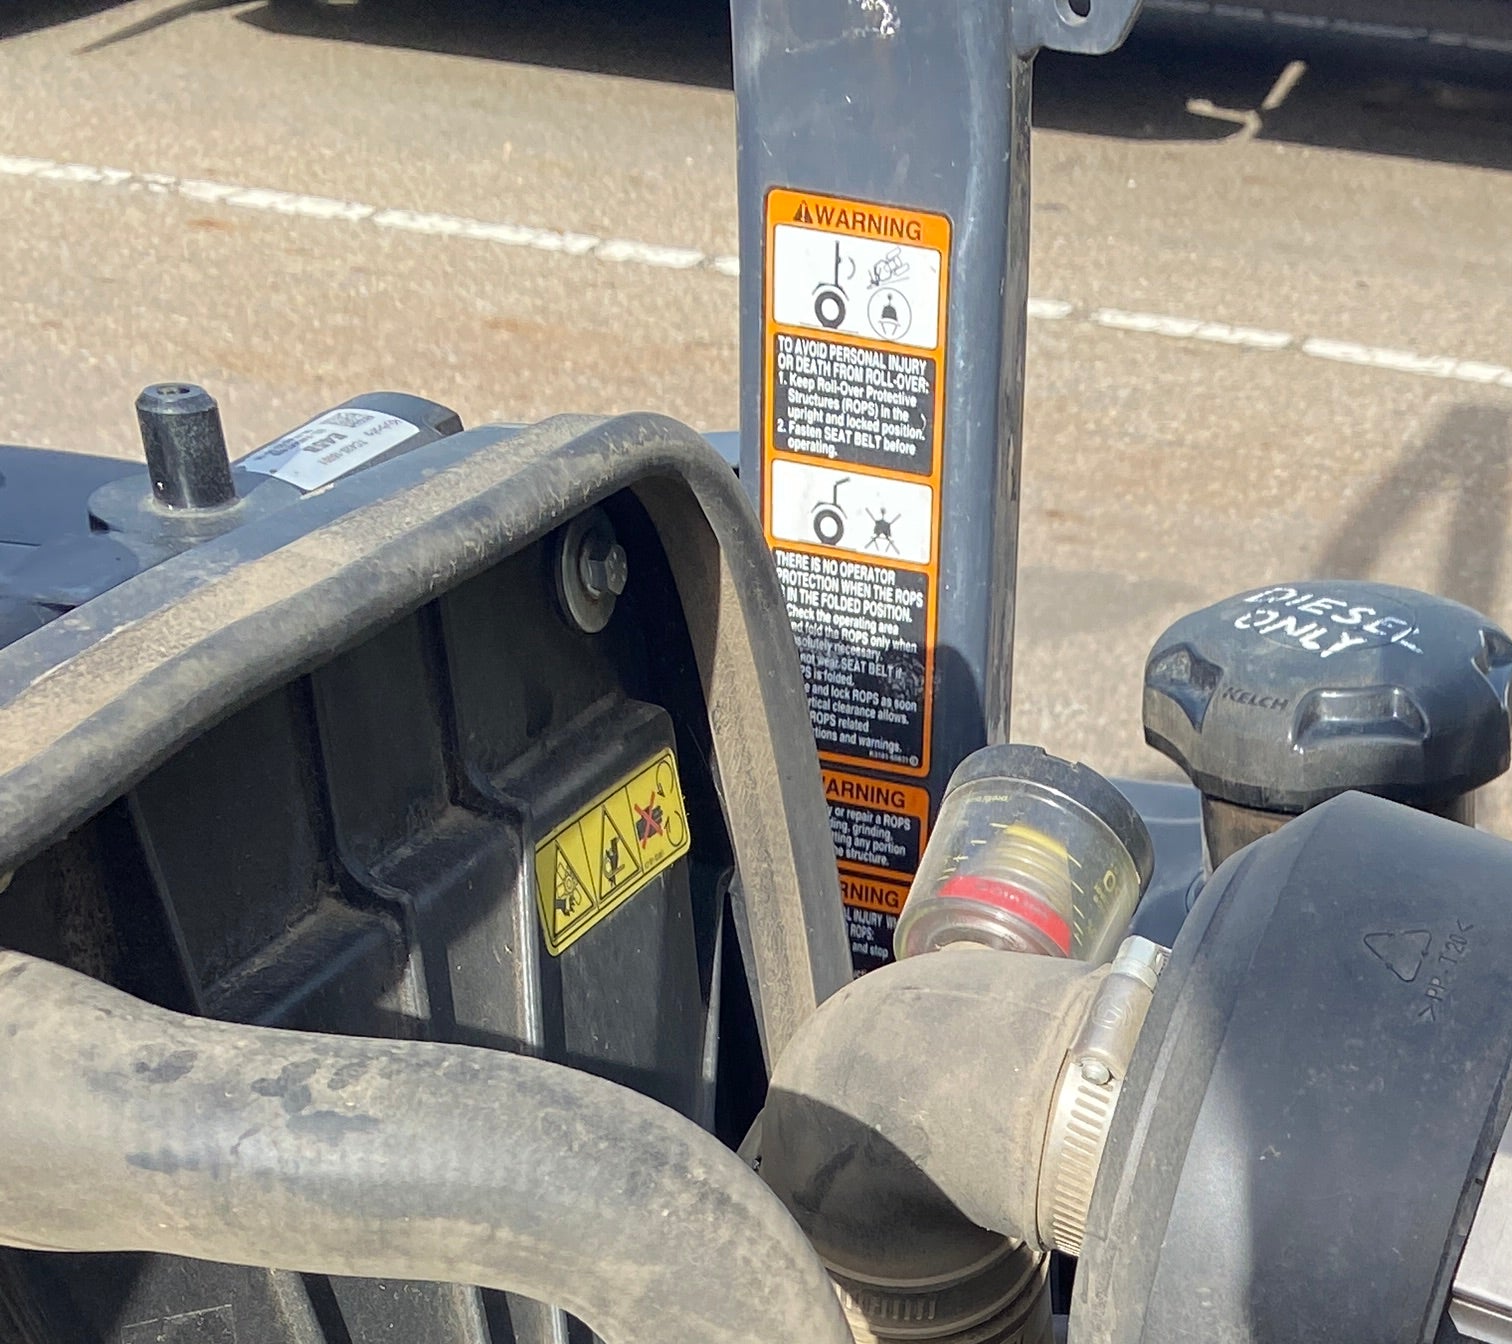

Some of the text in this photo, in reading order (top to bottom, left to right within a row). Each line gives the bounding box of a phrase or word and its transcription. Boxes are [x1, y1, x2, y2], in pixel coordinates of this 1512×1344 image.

[815, 203, 922, 241] WARNING
[777, 334, 927, 376] TO AVOID PERSONAL INJURY
[777, 352, 930, 395] OR DEATH FROM ROLL-OVER:
[778, 371, 918, 408] 1. Keep Roll-Over Protective
[787, 387, 910, 423] Structures (ROPS) in the
[787, 405, 926, 441] upright and locked position.
[788, 419, 823, 439] Fasten
[823, 426, 853, 444] SEAT
[853, 431, 882, 450] BELT
[883, 436, 917, 456] before
[787, 437, 838, 459] operating.
[775, 549, 896, 586] THERE IS NO OPERATOR
[776, 566, 840, 593] PROTECTION
[840, 579, 872, 599] WHEN
[872, 584, 894, 603] THE
[894, 587, 924, 609] ROPS
[786, 586, 798, 603] IN
[799, 588, 819, 607] THE
[820, 592, 862, 614] FOLDED
[863, 599, 913, 624] POSITION.
[786, 602, 900, 636] Check the operating area
[1233, 607, 1369, 659] ONLY
[1243, 586, 1425, 656] DIESEL
[790, 620, 918, 654] nd fold the ROPS only when
[799, 664, 812, 679] PS
[823, 669, 855, 687] folded.
[841, 656, 867, 673] SEAT
[867, 662, 895, 680] BELT
[811, 683, 830, 697] and
[830, 684, 851, 700] lock
[852, 688, 880, 706] ROPS
[893, 698, 918, 713] soon
[832, 700, 876, 719] clearance
[877, 708, 910, 725] allows.
[1221, 685, 1289, 712] KELCH
[809, 710, 870, 733] ROPS related
[838, 732, 857, 745] and
[858, 735, 903, 754] warnings.
[822, 776, 906, 808] ARNING
[834, 807, 846, 818] or
[846, 809, 874, 824] repair
[883, 813, 911, 832] ROPS
[852, 822, 894, 843] grinding,
[845, 847, 890, 867] structure.
[853, 836, 871, 851] any
[872, 840, 907, 857] portion
[839, 880, 899, 909] RNING
[852, 908, 883, 927] INJURY
[869, 944, 889, 961] stop
